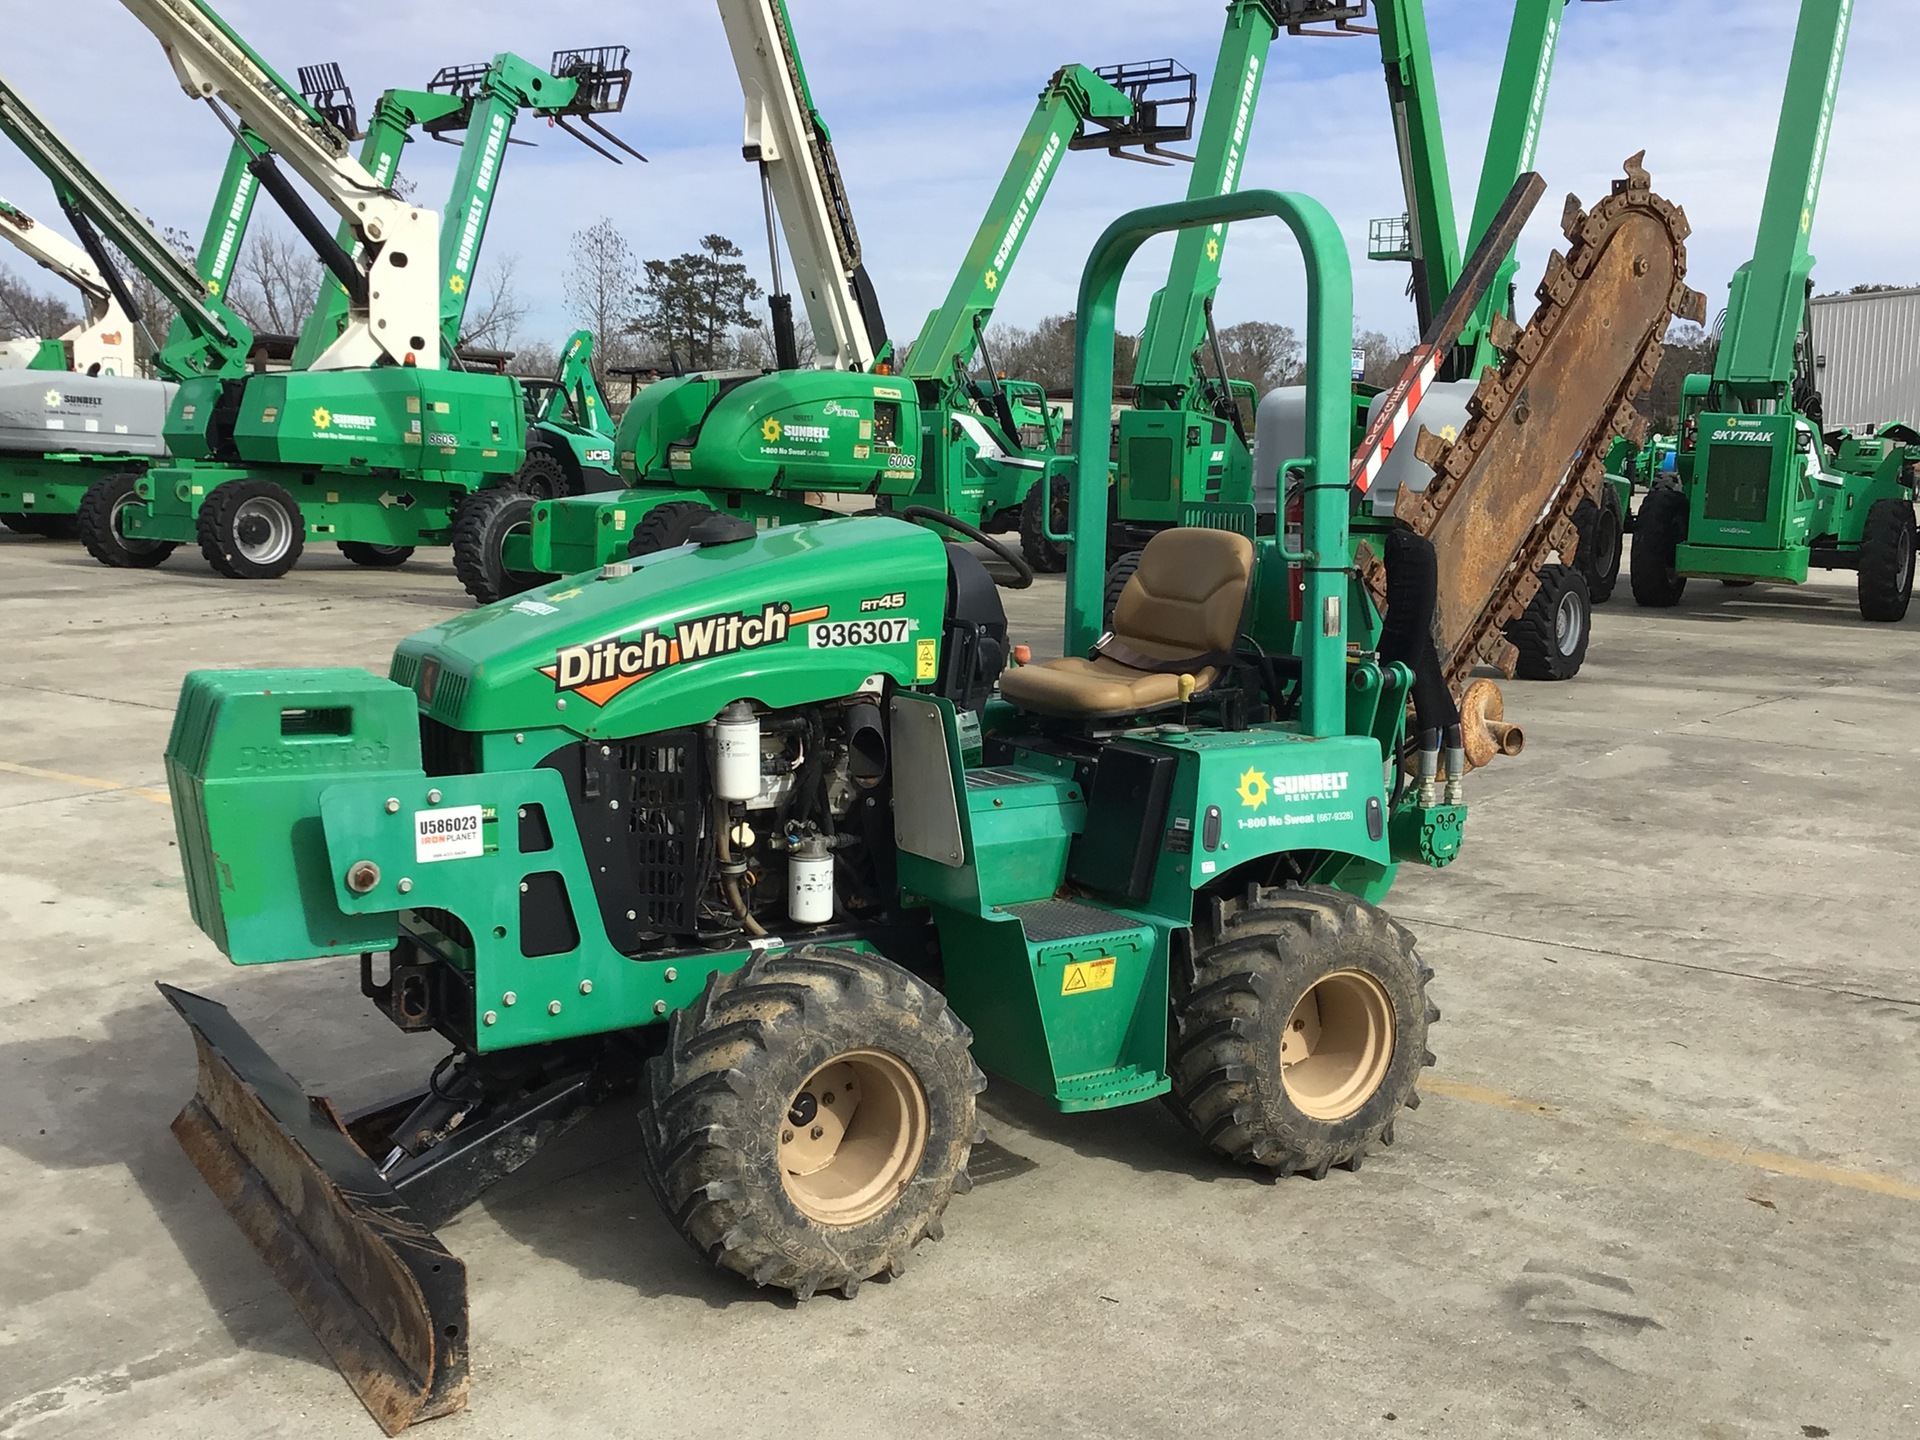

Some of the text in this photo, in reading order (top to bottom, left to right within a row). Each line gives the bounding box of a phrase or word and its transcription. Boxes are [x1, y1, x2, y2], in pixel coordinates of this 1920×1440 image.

[1533, 17, 1556, 115] RENTALS
[1233, 54, 1259, 146] RENTALS
[456, 114, 505, 273] SUNBELT RENTALS
[993, 132, 1060, 272] SUNBELT RENTALS
[211, 163, 253, 279] SUNBELT RENTAL
[64, 395, 102, 405] SUNBELT
[332, 413, 377, 427] SUNBELT
[1365, 379, 1409, 445] DANGER
[784, 425, 830, 439] SUNBELT
[1711, 430, 1774, 442] SKYTRAK
[586, 450, 611, 461] JCB
[888, 454, 916, 468] 600S
[1855, 448, 1879, 457] JLG
[861, 593, 905, 611] RT45
[816, 619, 907, 649] 936307
[559, 608, 786, 688] Ditch Witch
[1272, 771, 1349, 795] SUNBELT
[1284, 790, 1340, 802] RENTALS
[420, 816, 477, 835] U586023
[1237, 810, 1354, 829] 1-800 No Sweat (667-9328)
